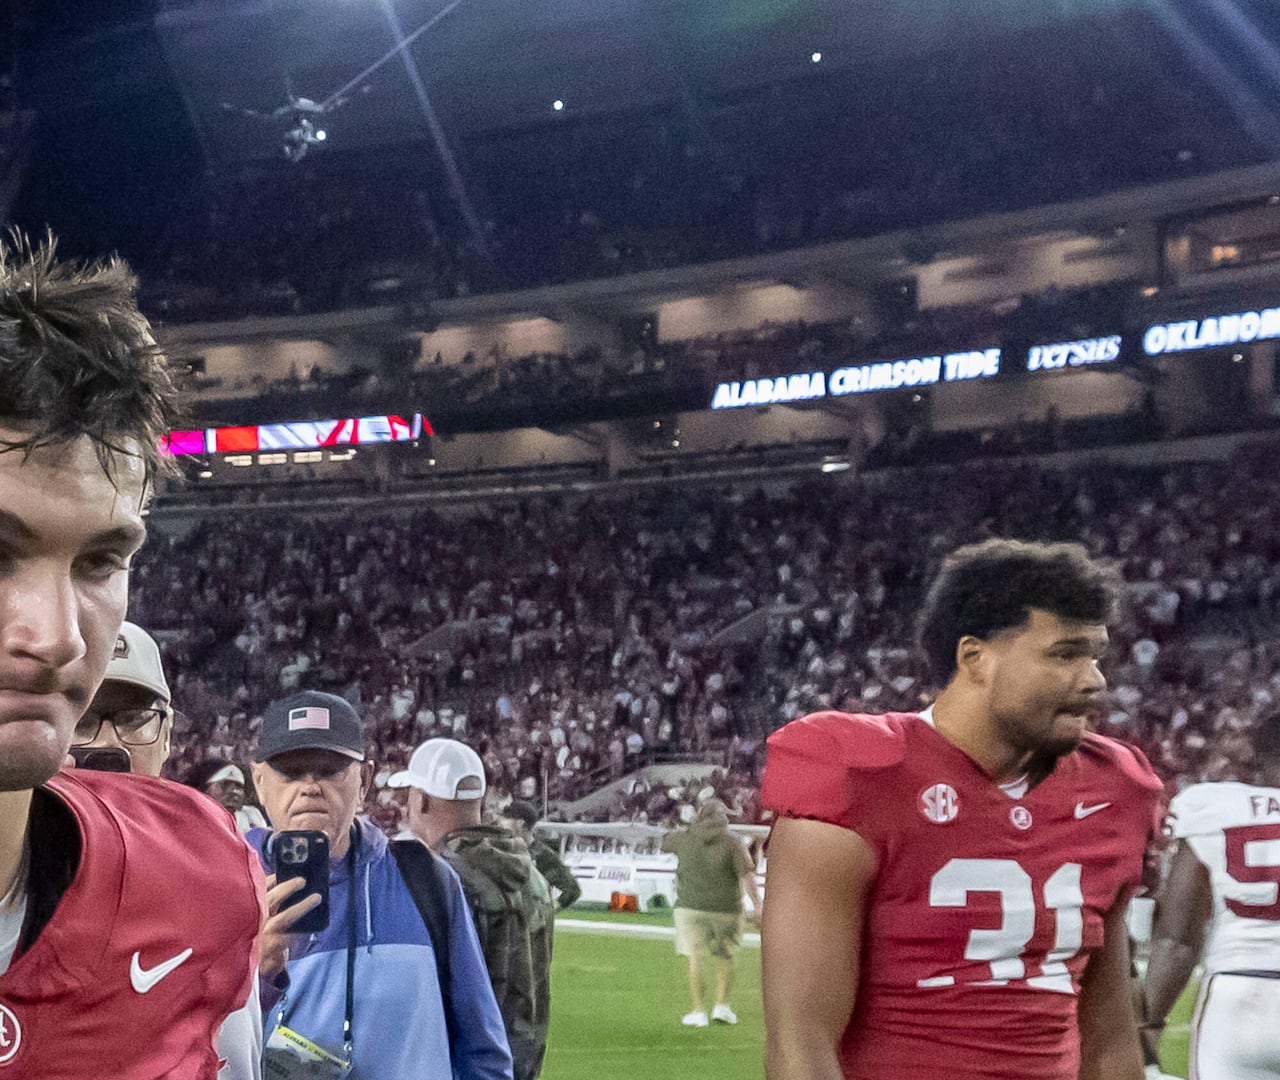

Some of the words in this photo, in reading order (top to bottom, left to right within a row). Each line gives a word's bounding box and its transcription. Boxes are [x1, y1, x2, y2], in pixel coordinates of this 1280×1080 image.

[711, 371, 825, 409] ALABAMA
[828, 356, 941, 396] CRIMSON
[943, 348, 1001, 382] TIDE
[921, 783, 959, 823] SEC
[917, 857, 1085, 994] 31
